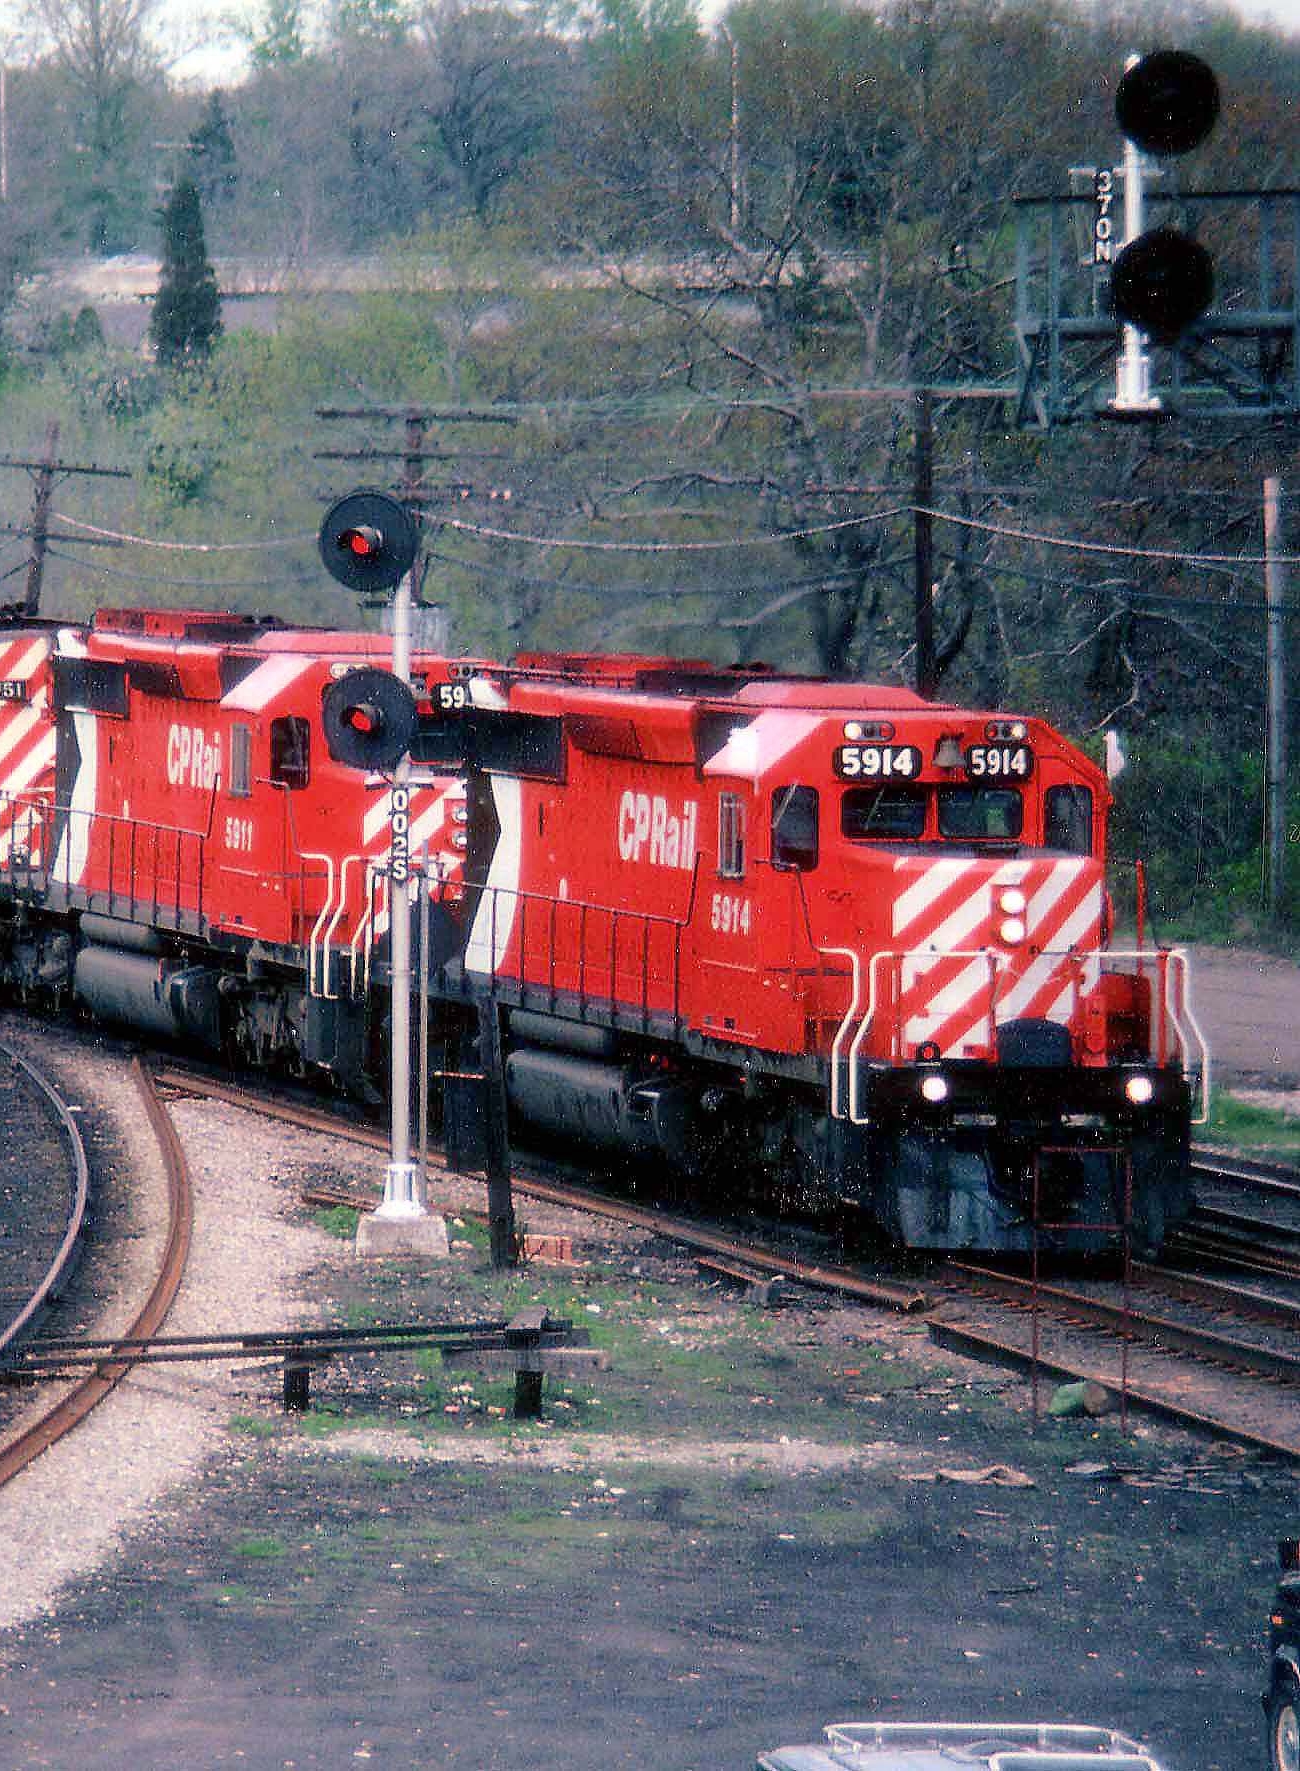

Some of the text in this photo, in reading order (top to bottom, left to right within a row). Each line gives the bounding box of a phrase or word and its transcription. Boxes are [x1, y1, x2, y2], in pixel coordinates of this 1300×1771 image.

[842, 748, 913, 776] 5914
[971, 748, 1027, 776] 5914
[225, 815, 253, 852] 5911
[392, 789, 408, 880] 002S
[711, 892, 750, 936] 5914
